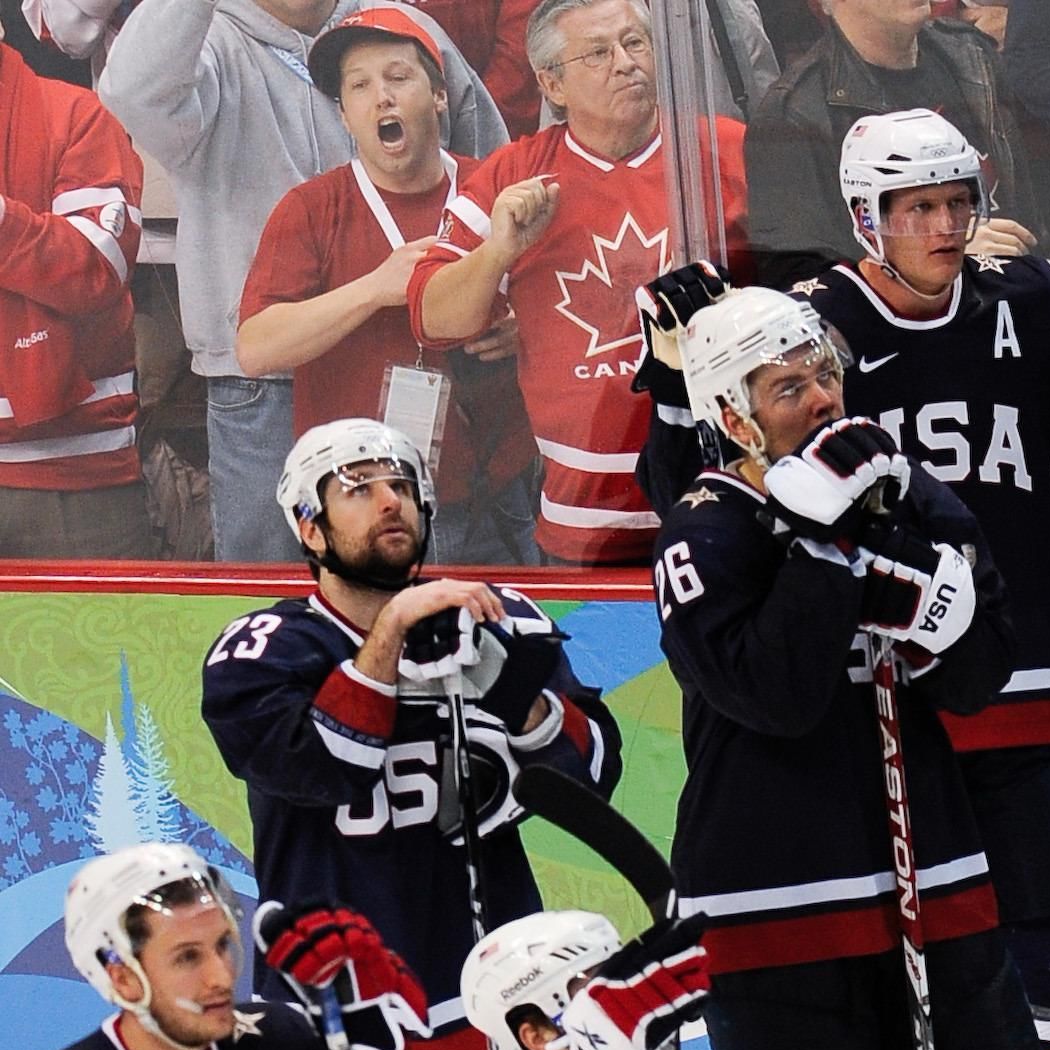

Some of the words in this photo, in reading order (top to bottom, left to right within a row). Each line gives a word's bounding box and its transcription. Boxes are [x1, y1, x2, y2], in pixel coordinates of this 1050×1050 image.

[994, 300, 1022, 359] A
[654, 541, 705, 622] 26
[918, 583, 957, 634] USA
[206, 613, 283, 668] 23
[873, 683, 918, 922] EASTON
[501, 965, 544, 1002] Reebok
